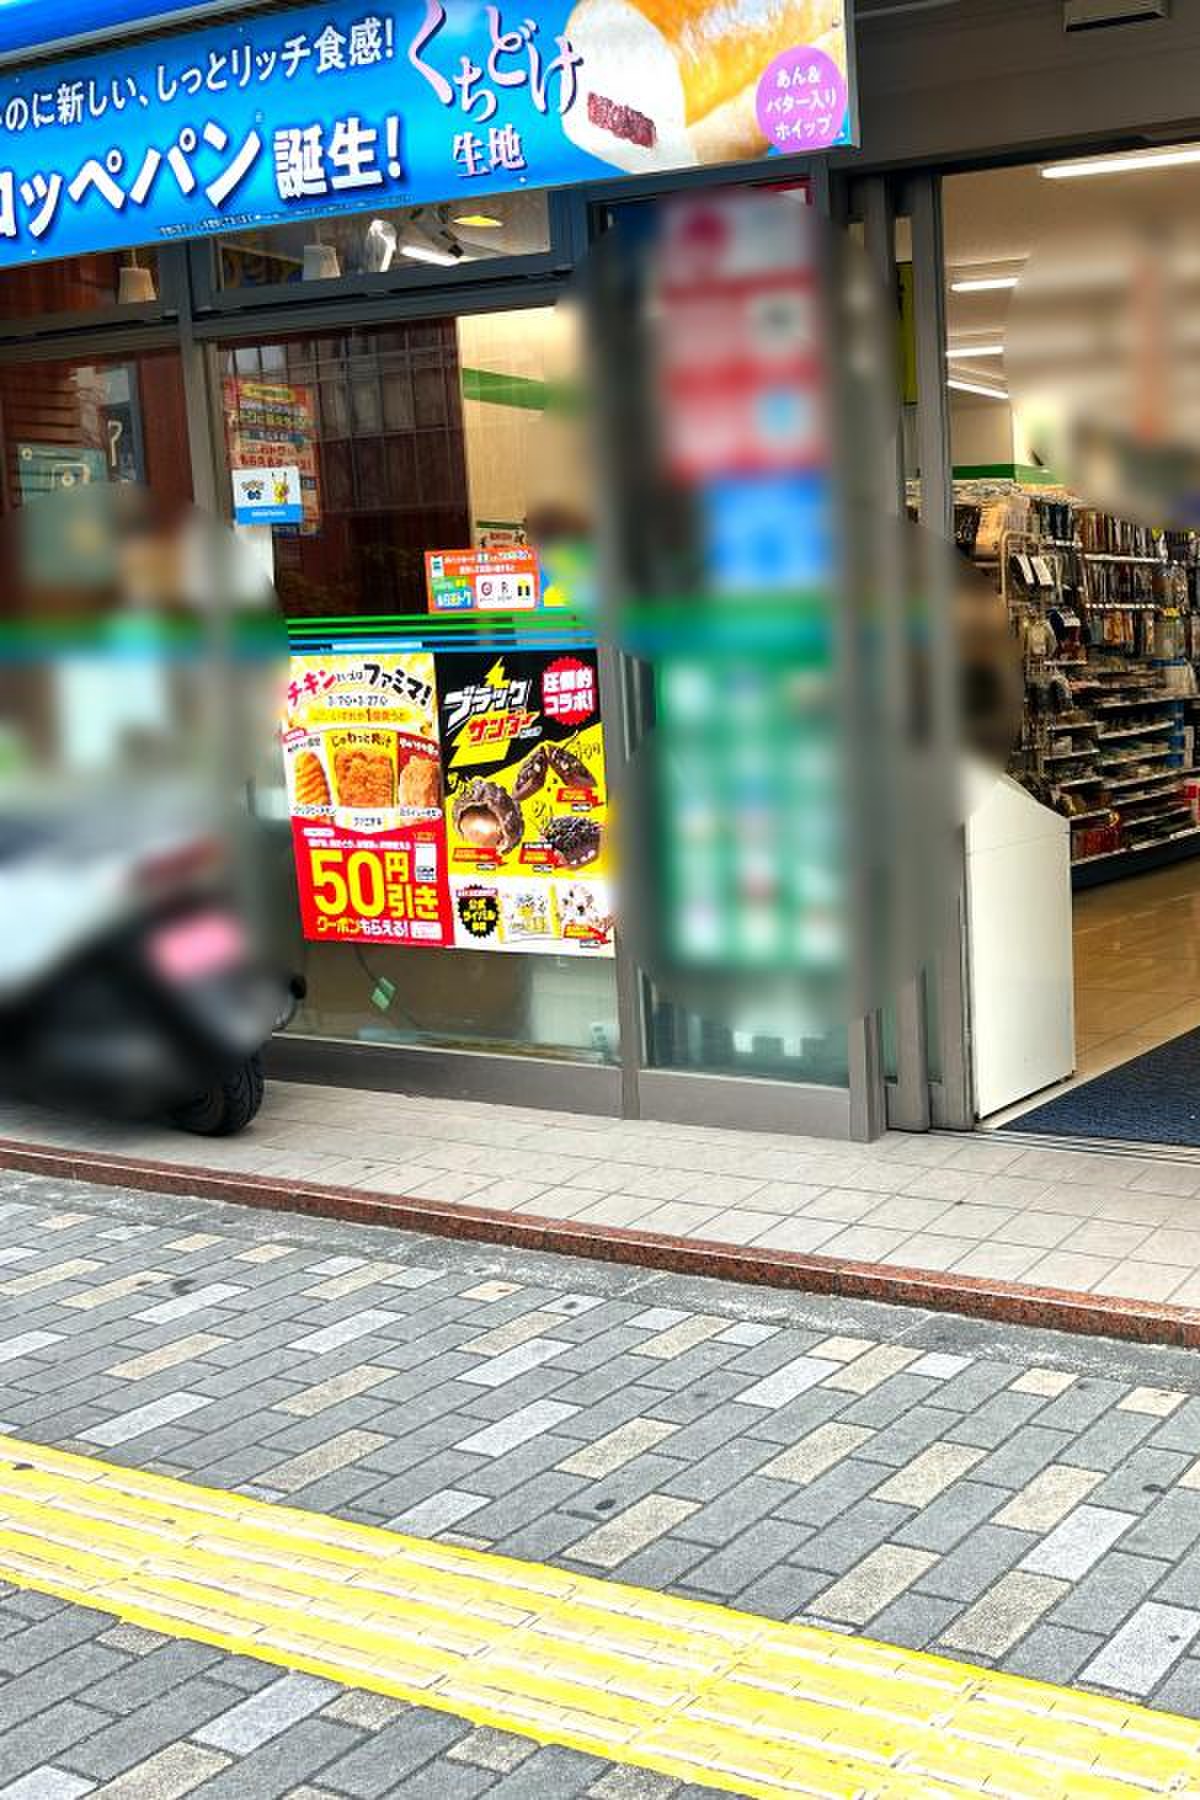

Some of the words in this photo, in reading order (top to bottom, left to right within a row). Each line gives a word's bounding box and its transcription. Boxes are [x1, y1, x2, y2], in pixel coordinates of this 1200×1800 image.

[0, 18, 394, 131] のに新しい、しっとリッチ食感!
[408, 0, 583, 122] くちどけ
[776, 68, 820, 87] あん&
[767, 88, 837, 114] バター入り
[452, 124, 526, 176] 生地
[774, 116, 833, 141] ホイップ
[443, 679, 532, 735] ブラック
